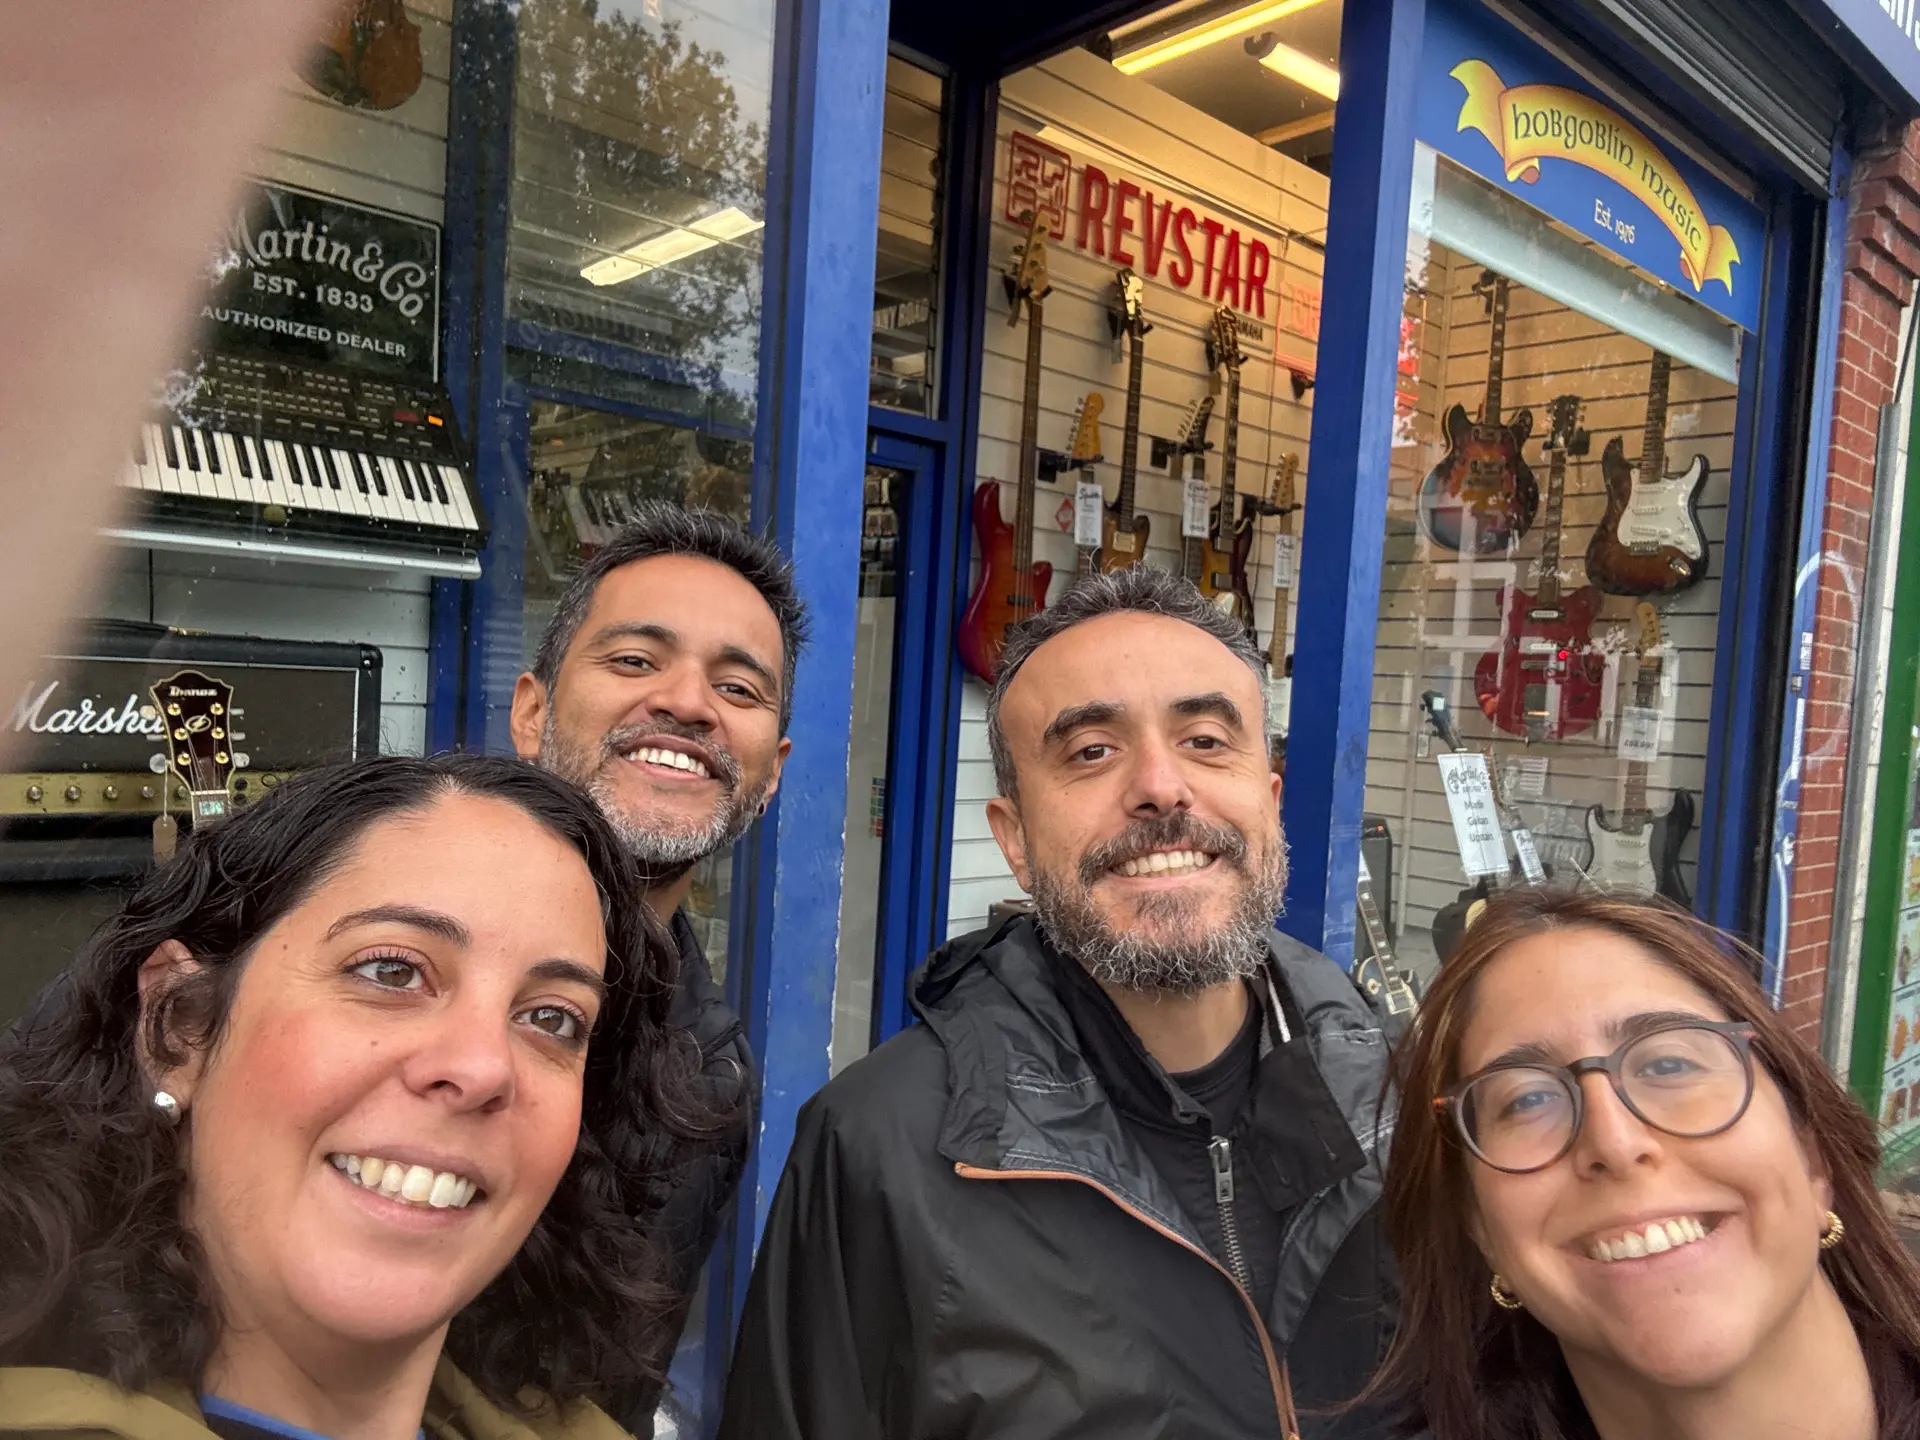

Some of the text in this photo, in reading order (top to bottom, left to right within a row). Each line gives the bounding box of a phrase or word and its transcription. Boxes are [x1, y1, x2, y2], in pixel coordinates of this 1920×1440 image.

[1641, 159, 1702, 252] music
[1076, 163, 1270, 319] REVSTAR
[252, 271, 375, 314] EST. 1833
[200, 304, 407, 358] AUTHORIZED DEALER
[8, 680, 165, 734] Marsha
